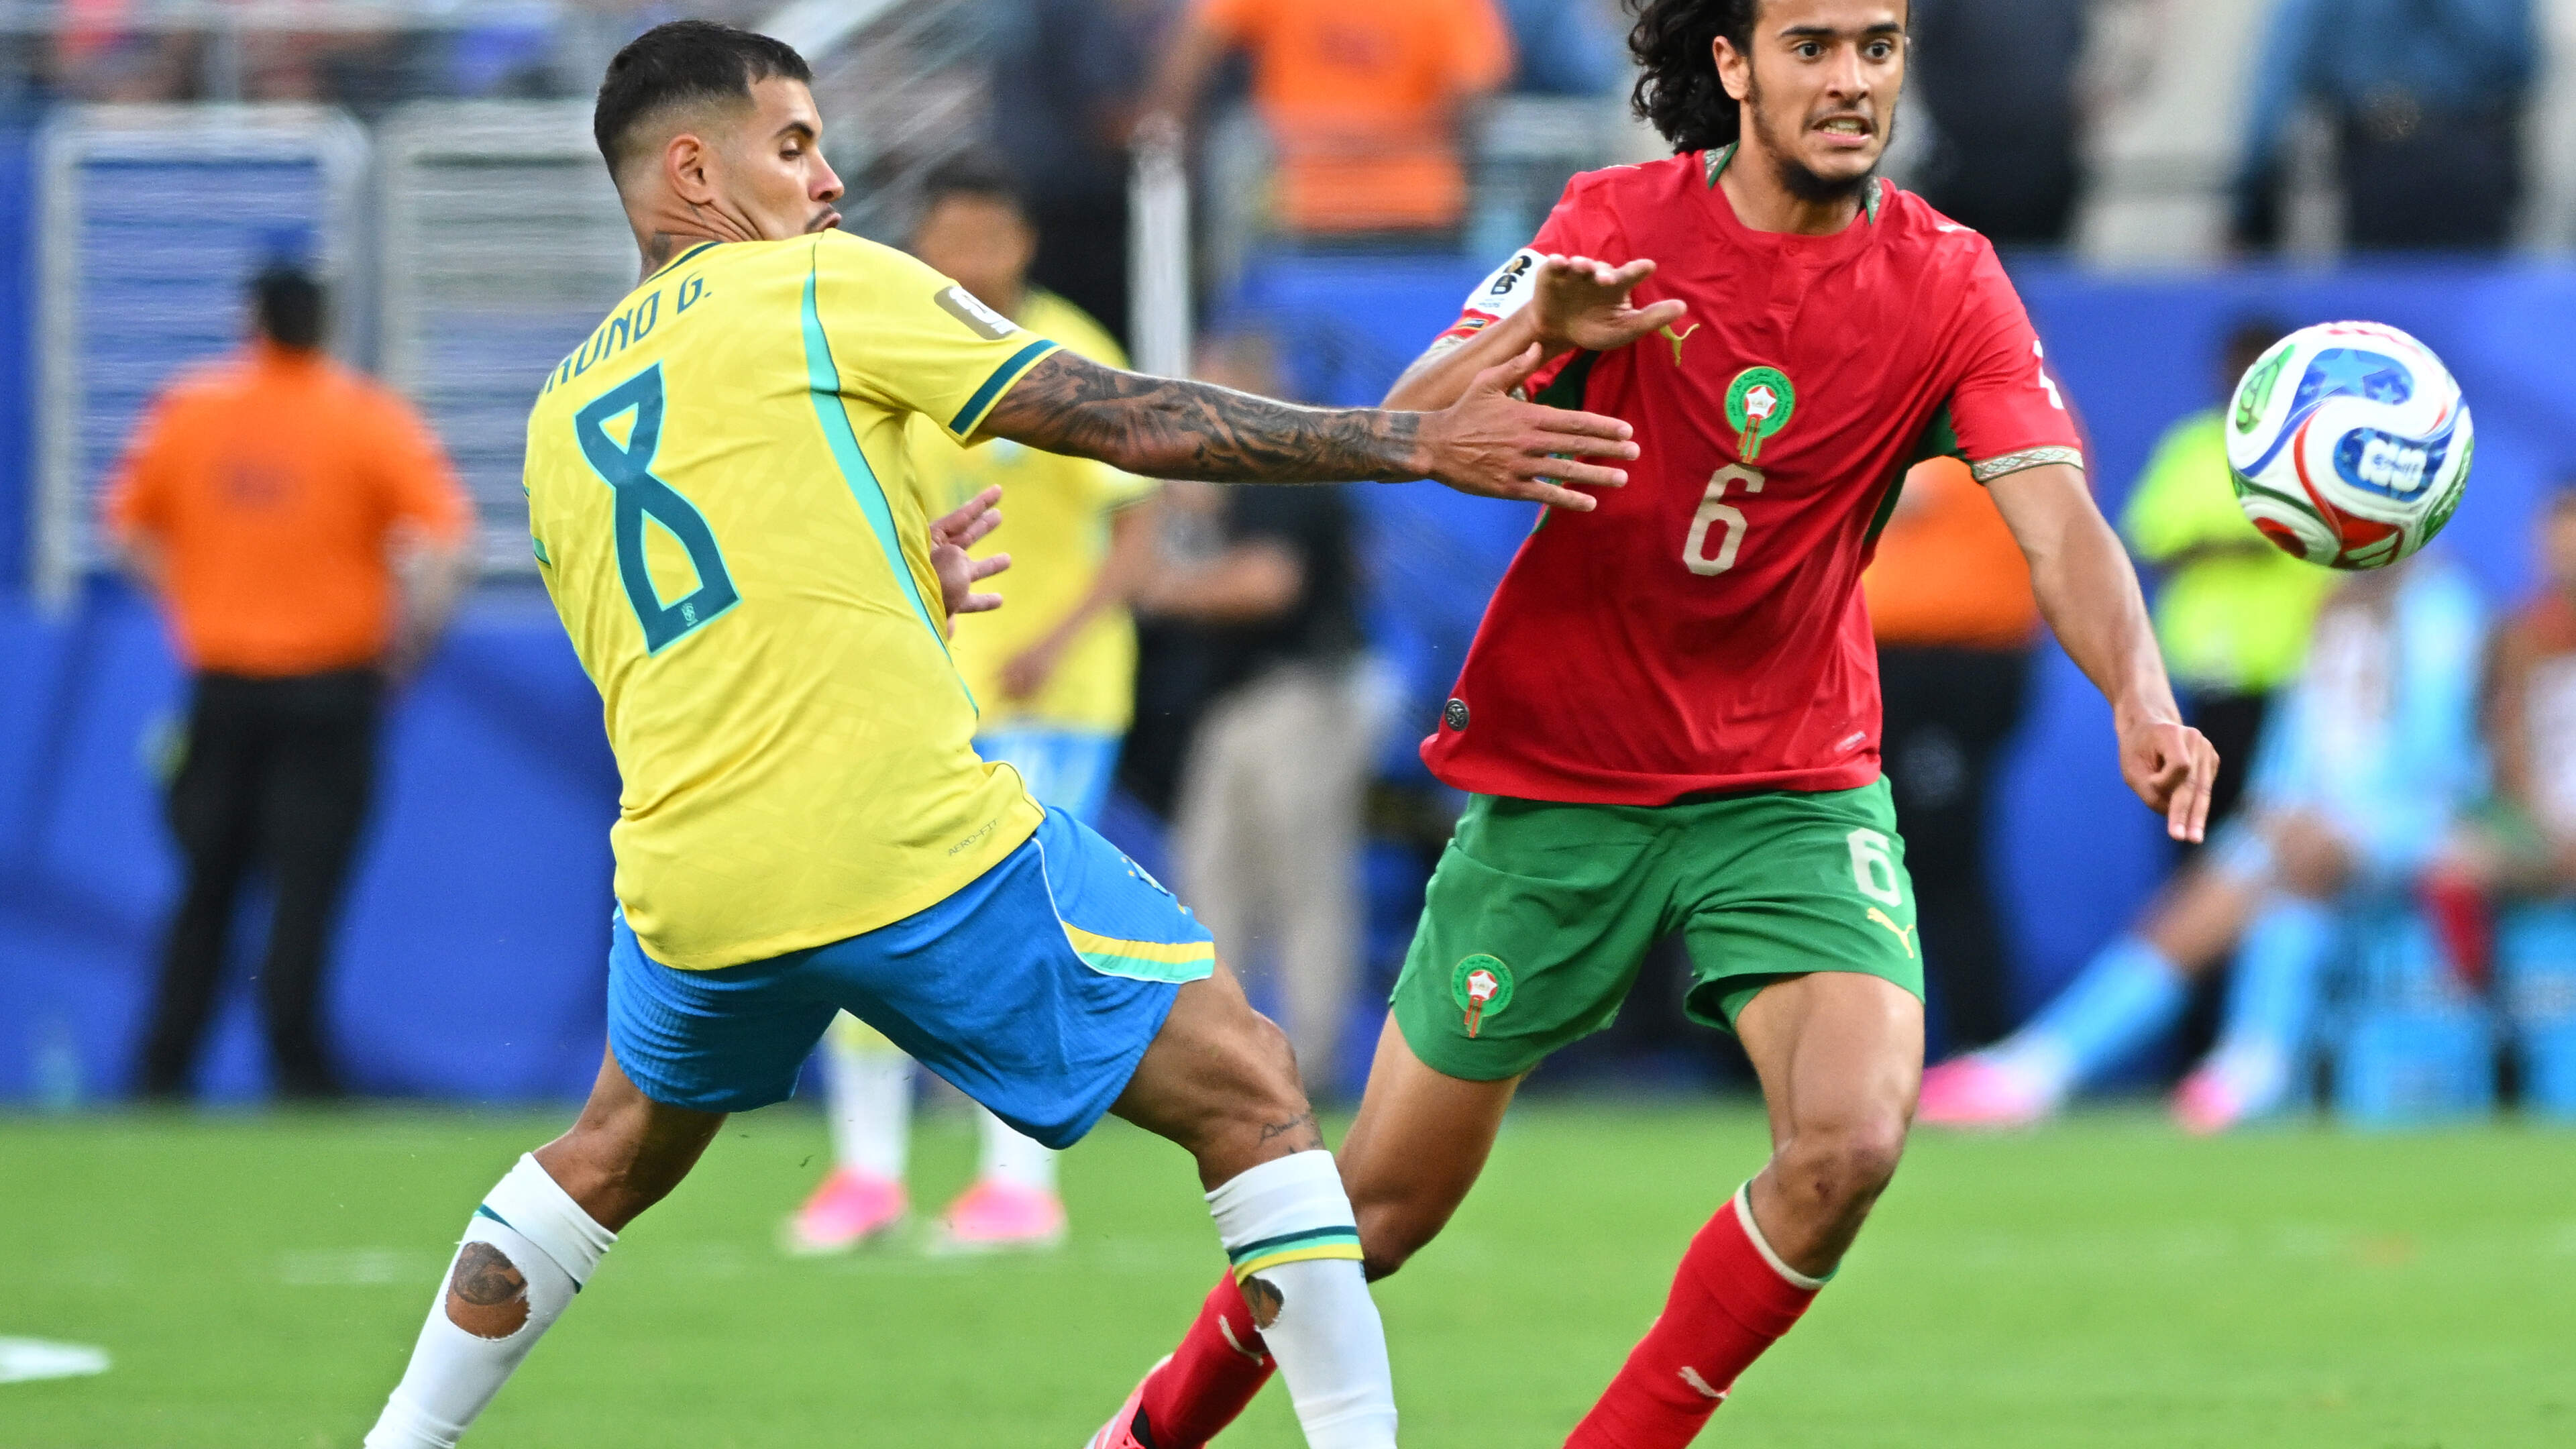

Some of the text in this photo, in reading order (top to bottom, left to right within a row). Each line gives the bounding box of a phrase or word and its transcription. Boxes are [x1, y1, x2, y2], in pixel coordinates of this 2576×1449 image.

[677, 270, 712, 315] G.
[574, 358, 743, 658] 8
[1682, 463, 1766, 576] 6
[1847, 827, 1902, 908] 6
